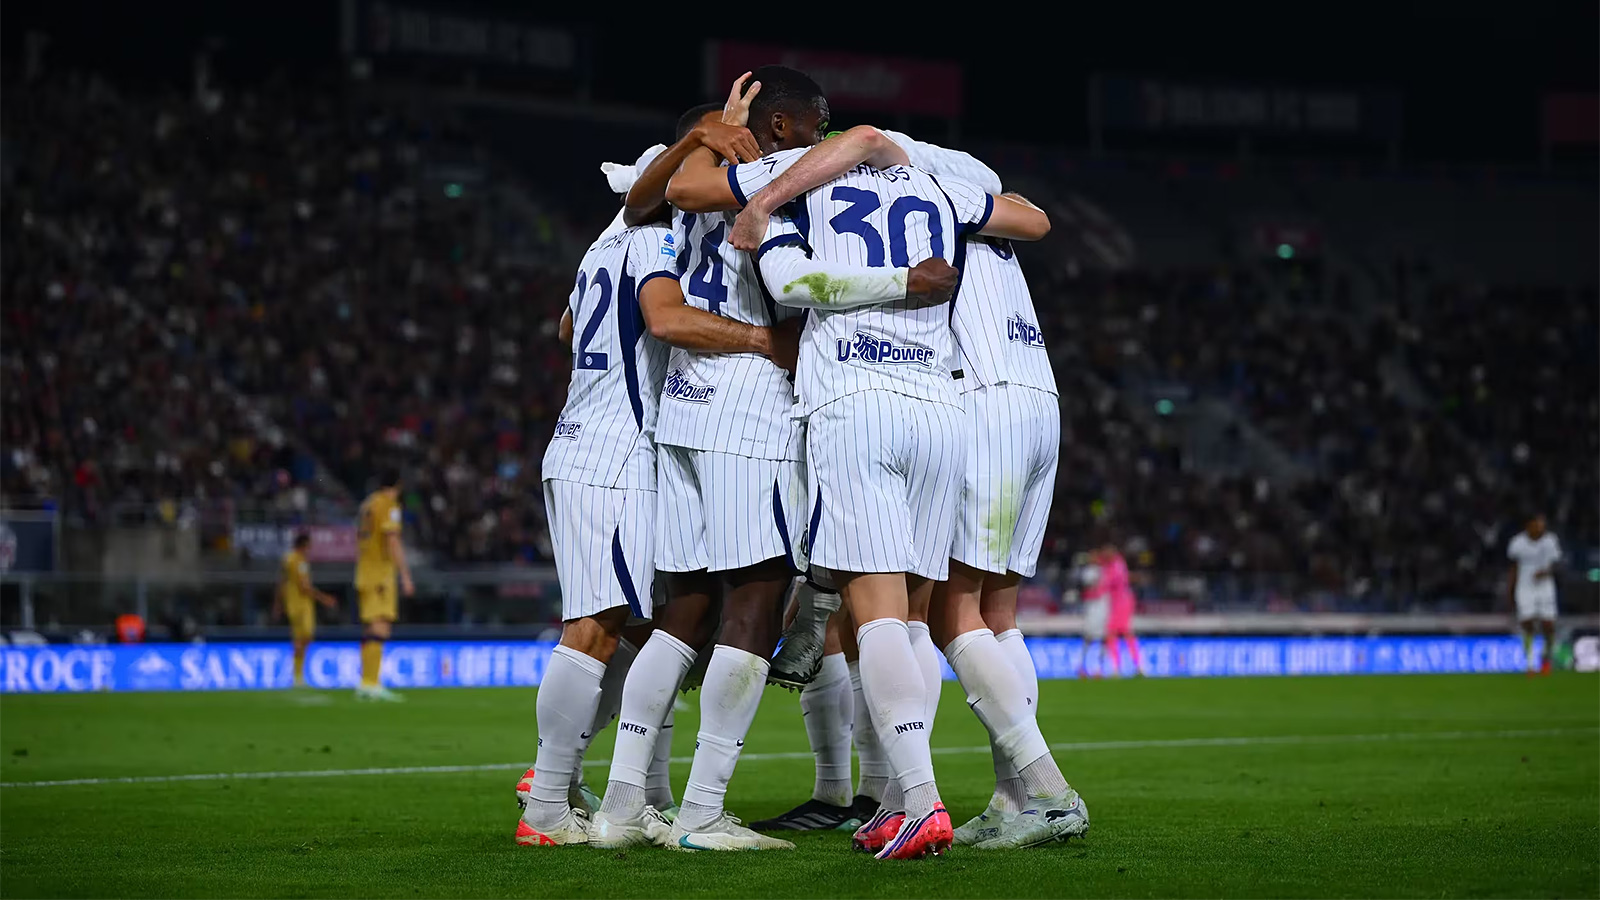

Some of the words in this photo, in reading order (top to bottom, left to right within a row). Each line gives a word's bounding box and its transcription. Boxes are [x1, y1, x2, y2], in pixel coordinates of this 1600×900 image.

[829, 186, 944, 267] 30
[1007, 318, 1044, 345] U-Po
[836, 336, 934, 364] U-Power
[0, 650, 115, 691] ROCE
[308, 648, 432, 688] CRCE
[620, 722, 648, 736] INTER
[895, 721, 925, 734] INTER
